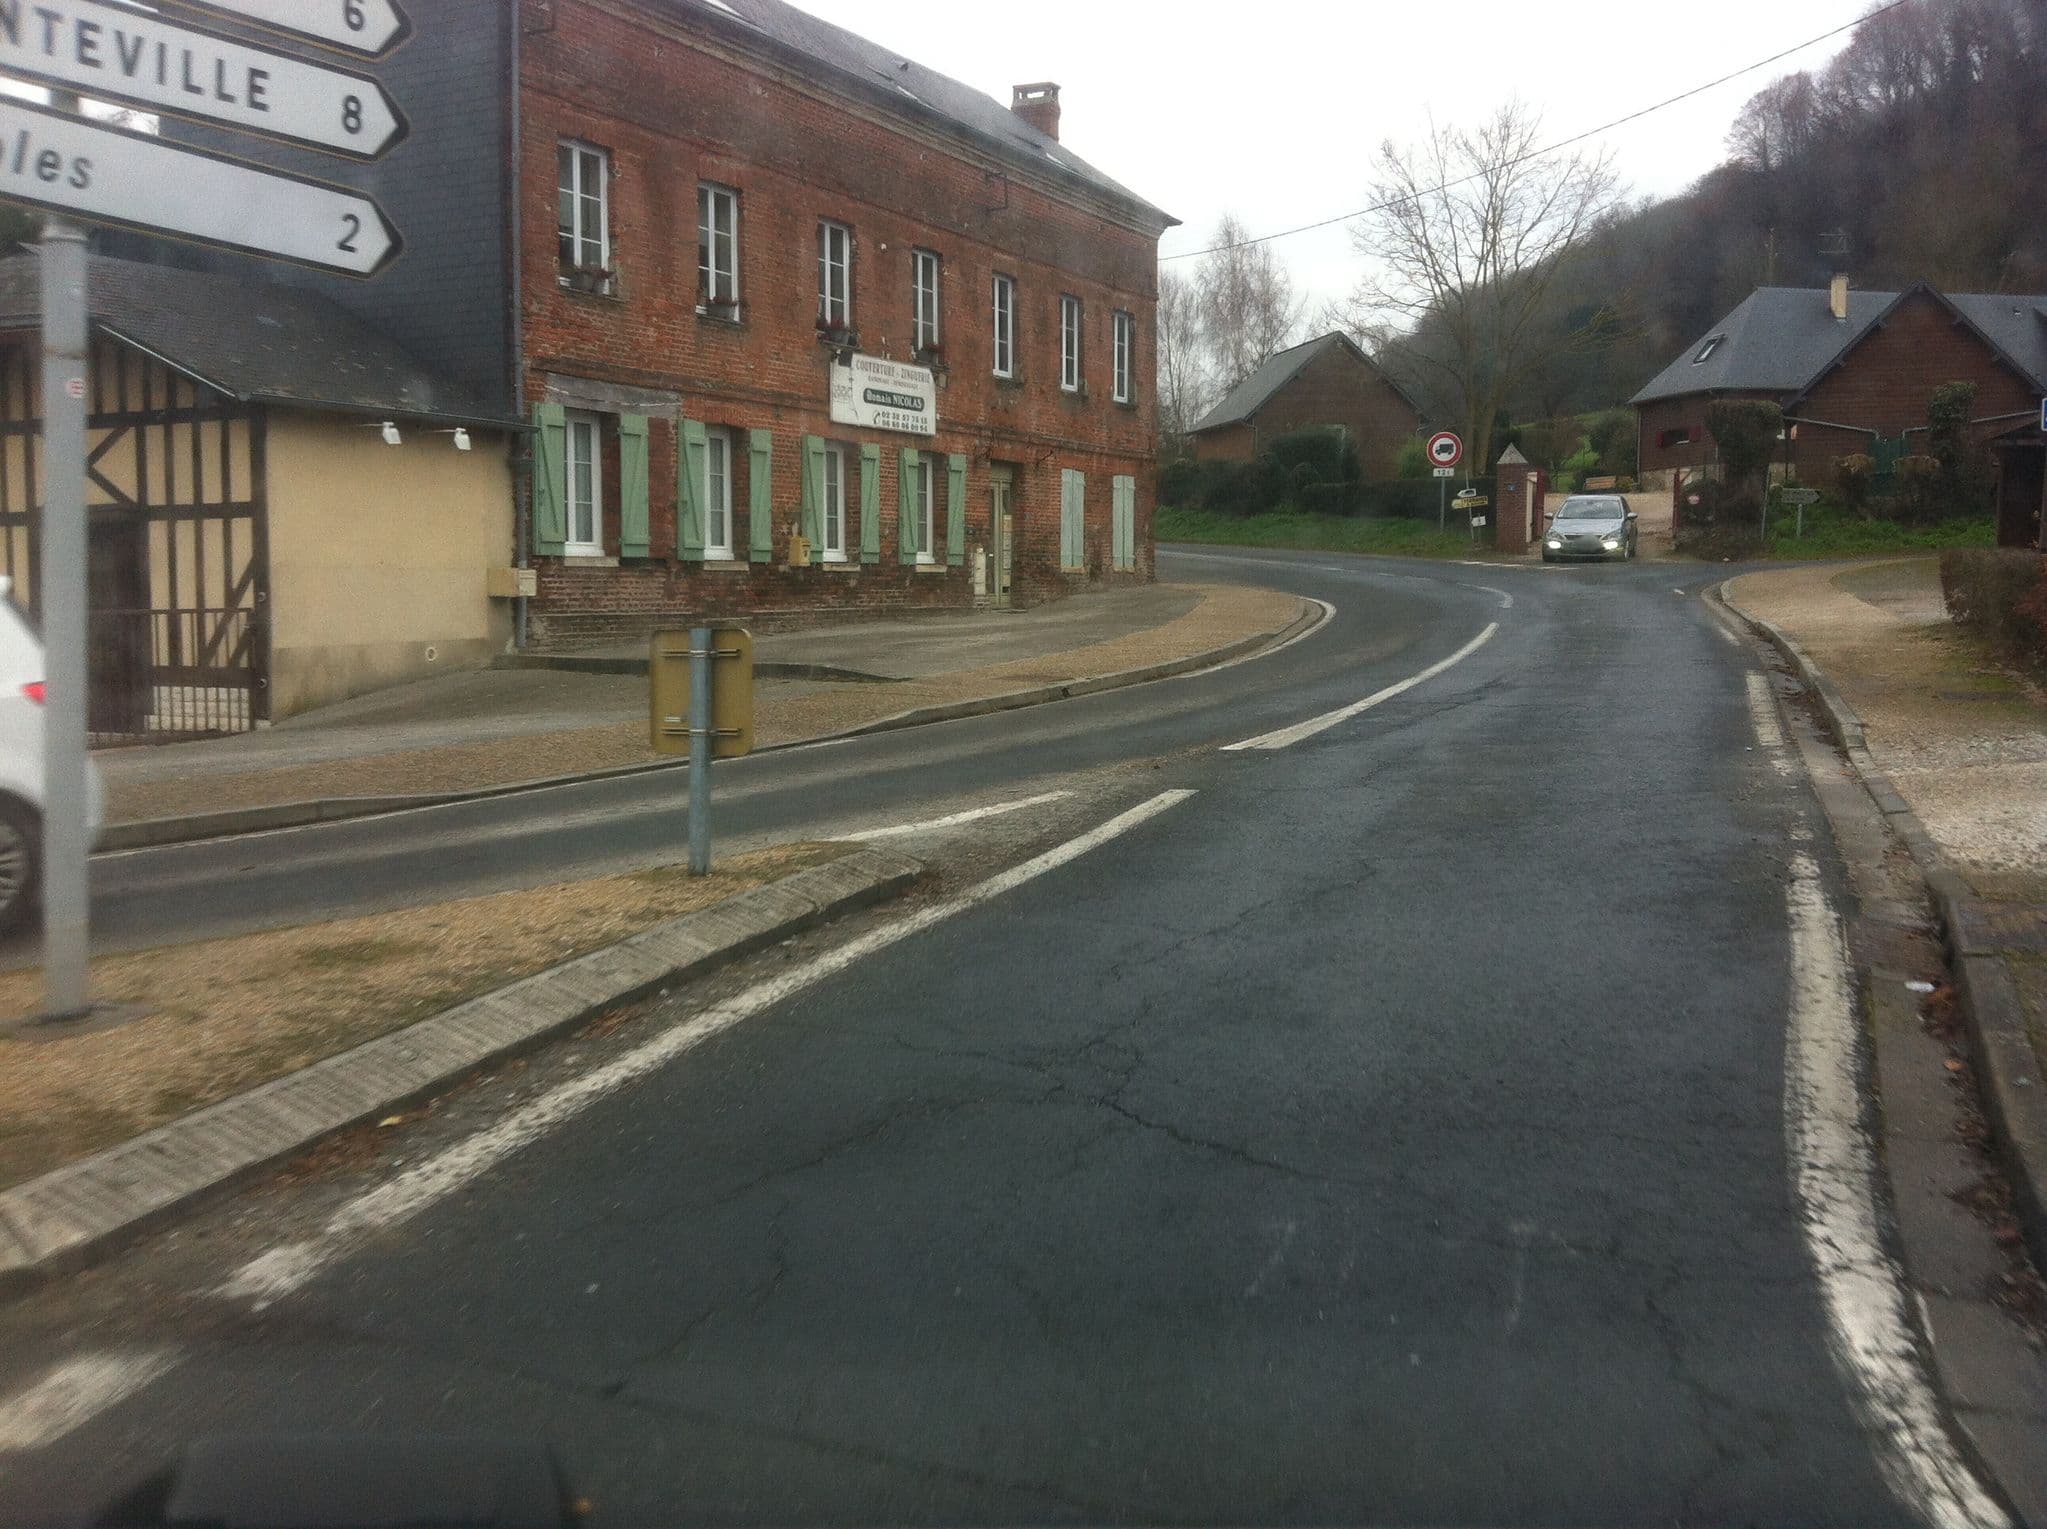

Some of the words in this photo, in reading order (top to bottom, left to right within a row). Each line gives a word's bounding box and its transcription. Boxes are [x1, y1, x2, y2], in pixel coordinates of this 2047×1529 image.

[343, 0, 365, 31] 6
[341, 94, 363, 135] 8
[0, 129, 94, 190] les
[336, 213, 361, 254] 2
[892, 394, 922, 409] NICOLAS
